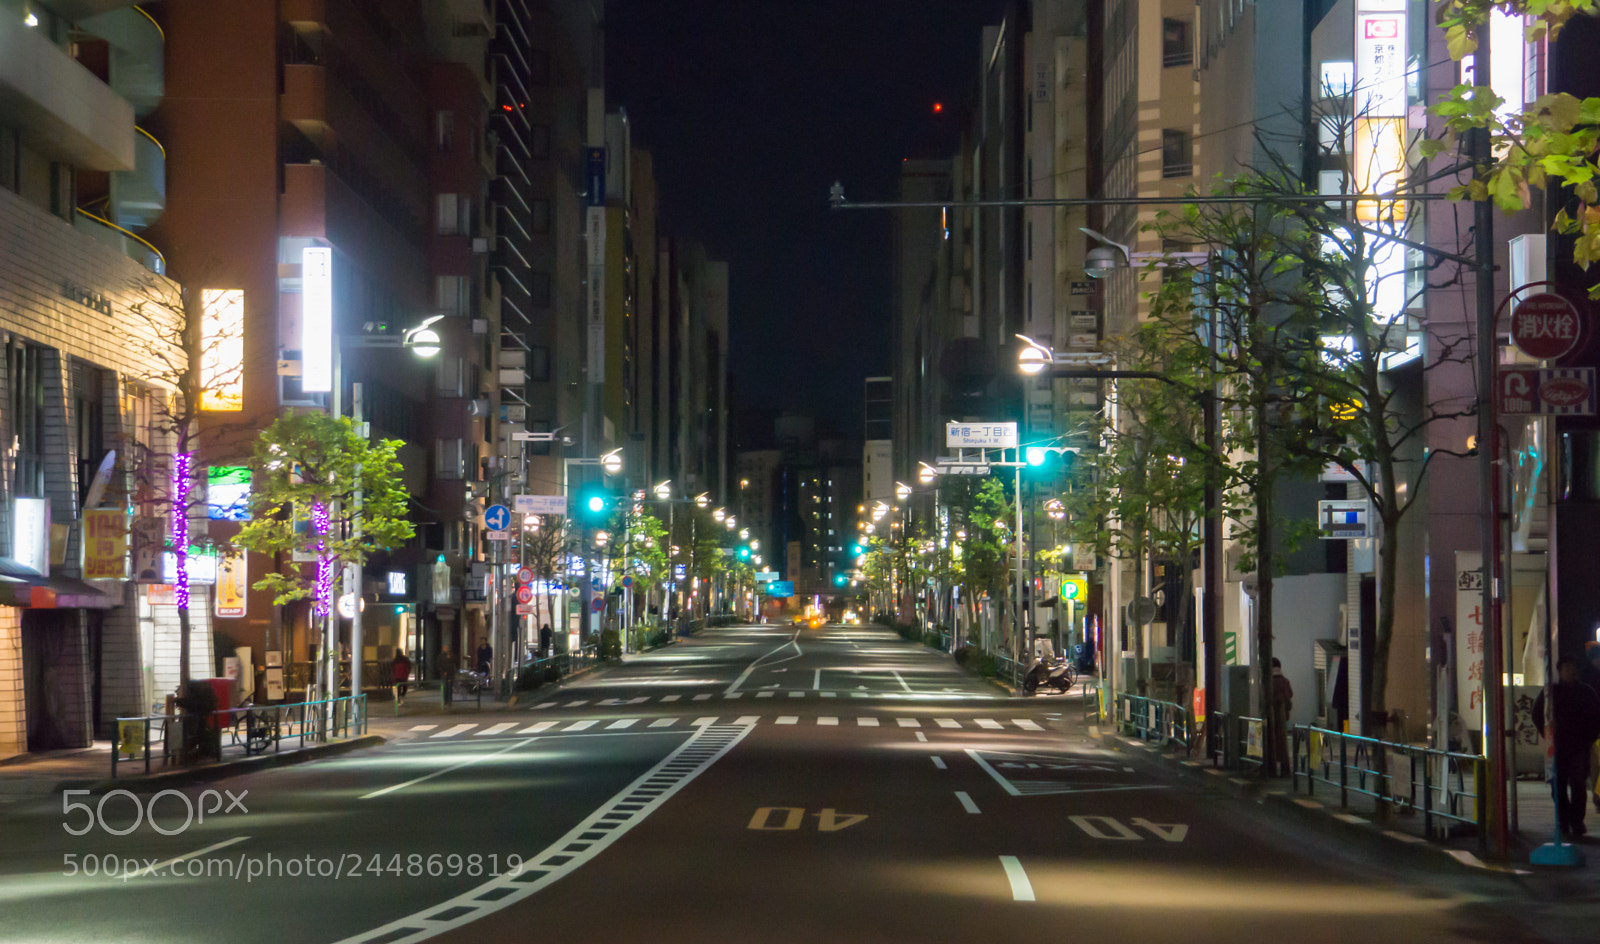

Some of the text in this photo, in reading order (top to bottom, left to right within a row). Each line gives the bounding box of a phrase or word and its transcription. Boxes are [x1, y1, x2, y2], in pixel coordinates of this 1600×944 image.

[1517, 314, 1573, 338] 消火栓
[1503, 398, 1531, 412] 100m
[950, 427, 1013, 437] 新宿一丁目西
[1065, 583, 1077, 598] P
[747, 806, 869, 831] 40
[1068, 815, 1189, 842] 40
